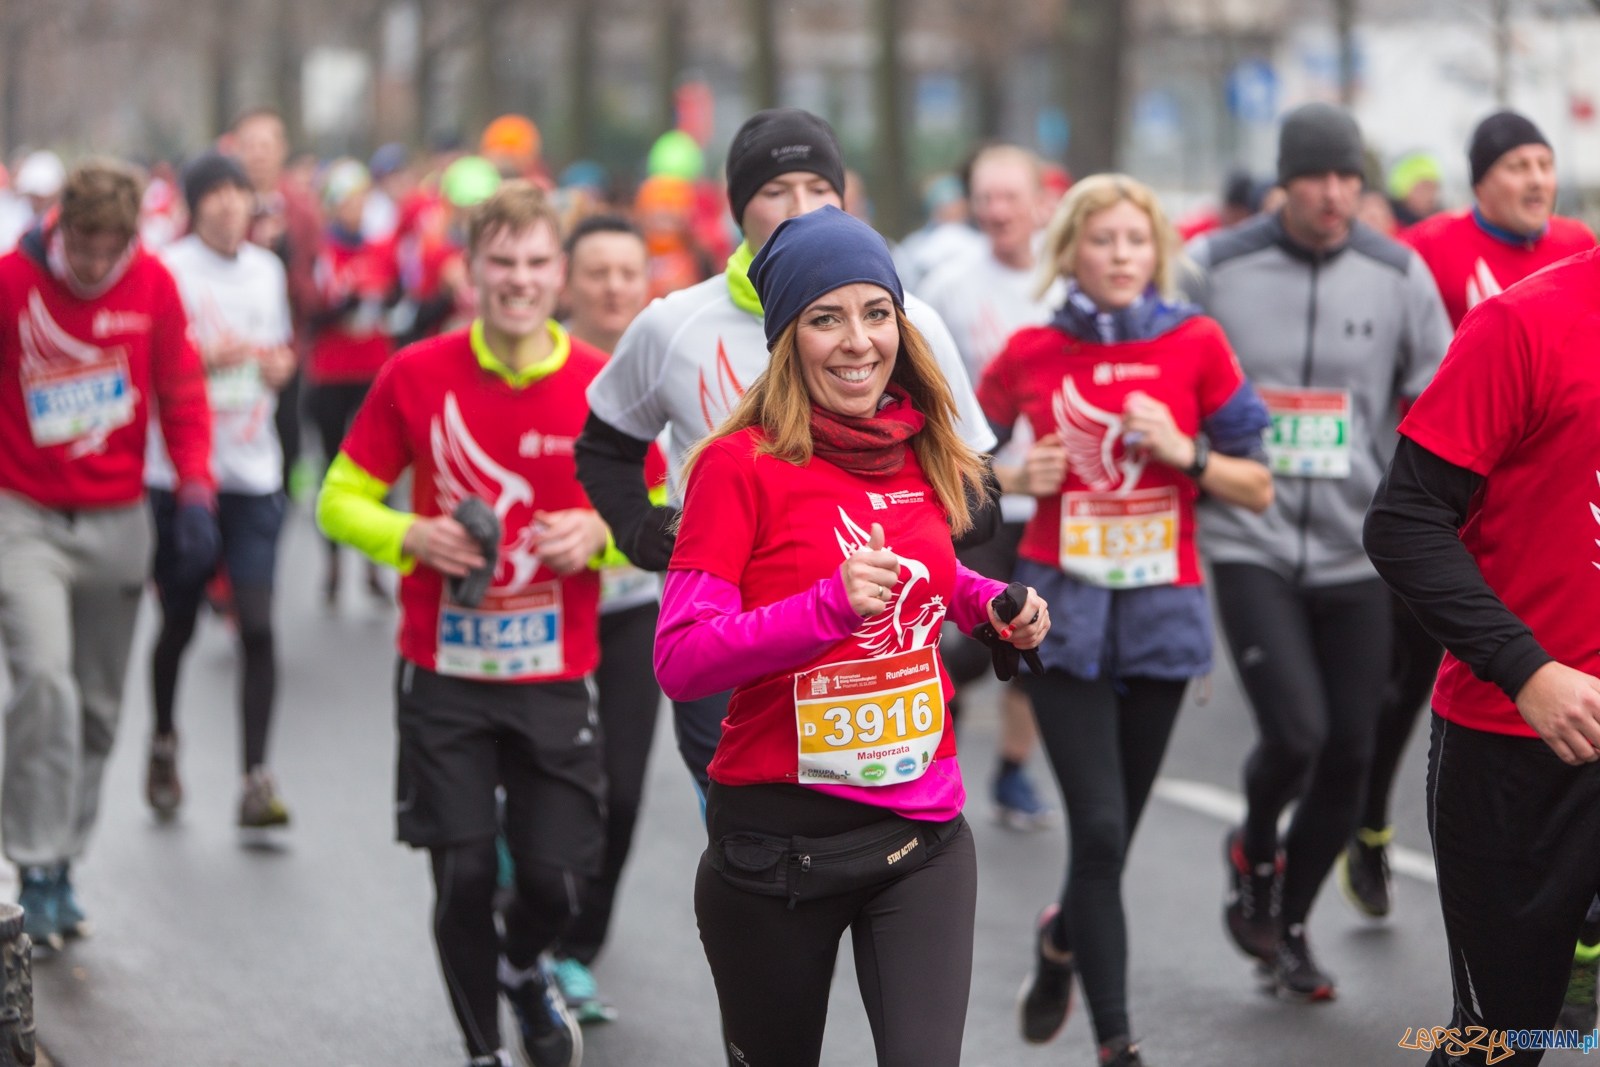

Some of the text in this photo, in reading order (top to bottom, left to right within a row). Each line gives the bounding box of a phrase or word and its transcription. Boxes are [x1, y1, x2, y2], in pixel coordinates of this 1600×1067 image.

[1083, 519, 1164, 554] 1532
[457, 614, 547, 648] 1546
[833, 675, 842, 690] 1
[886, 663, 929, 679] RunPoland.org
[804, 692, 933, 747] D 3916
[887, 837, 918, 865] STAY ACTIVE
